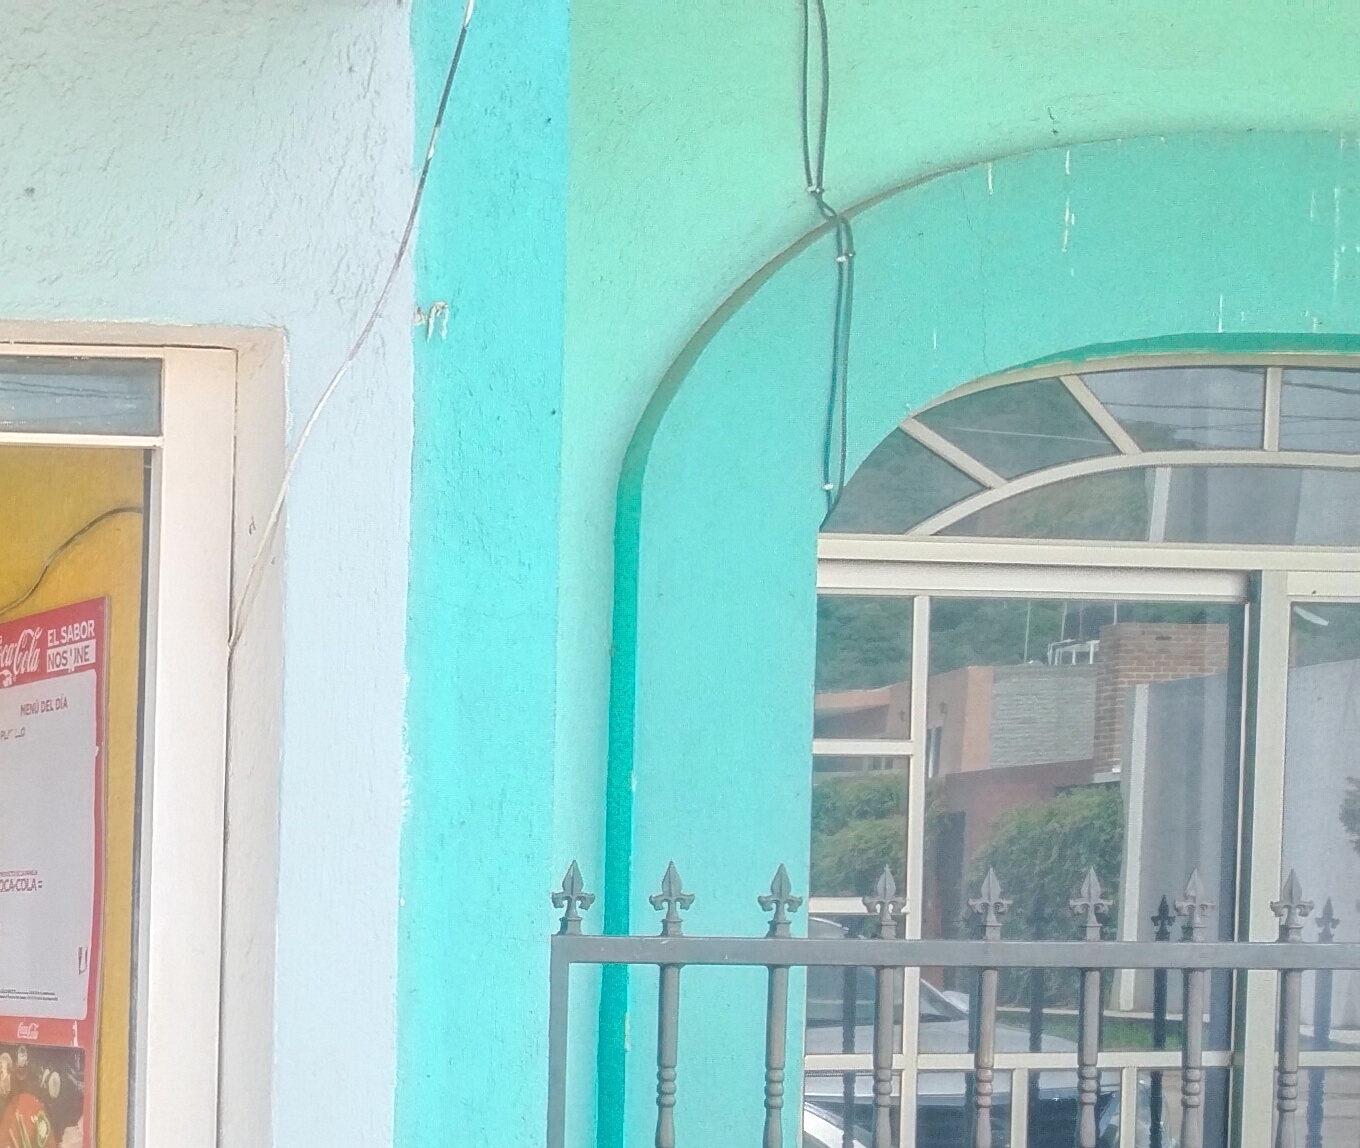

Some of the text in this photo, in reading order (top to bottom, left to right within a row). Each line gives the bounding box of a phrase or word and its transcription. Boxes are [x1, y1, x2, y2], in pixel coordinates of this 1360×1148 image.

[48, 628, 59, 647] EL
[61, 619, 95, 644] SABOR
[47, 650, 68, 671] NOS
[41, 699, 54, 713] DEL
